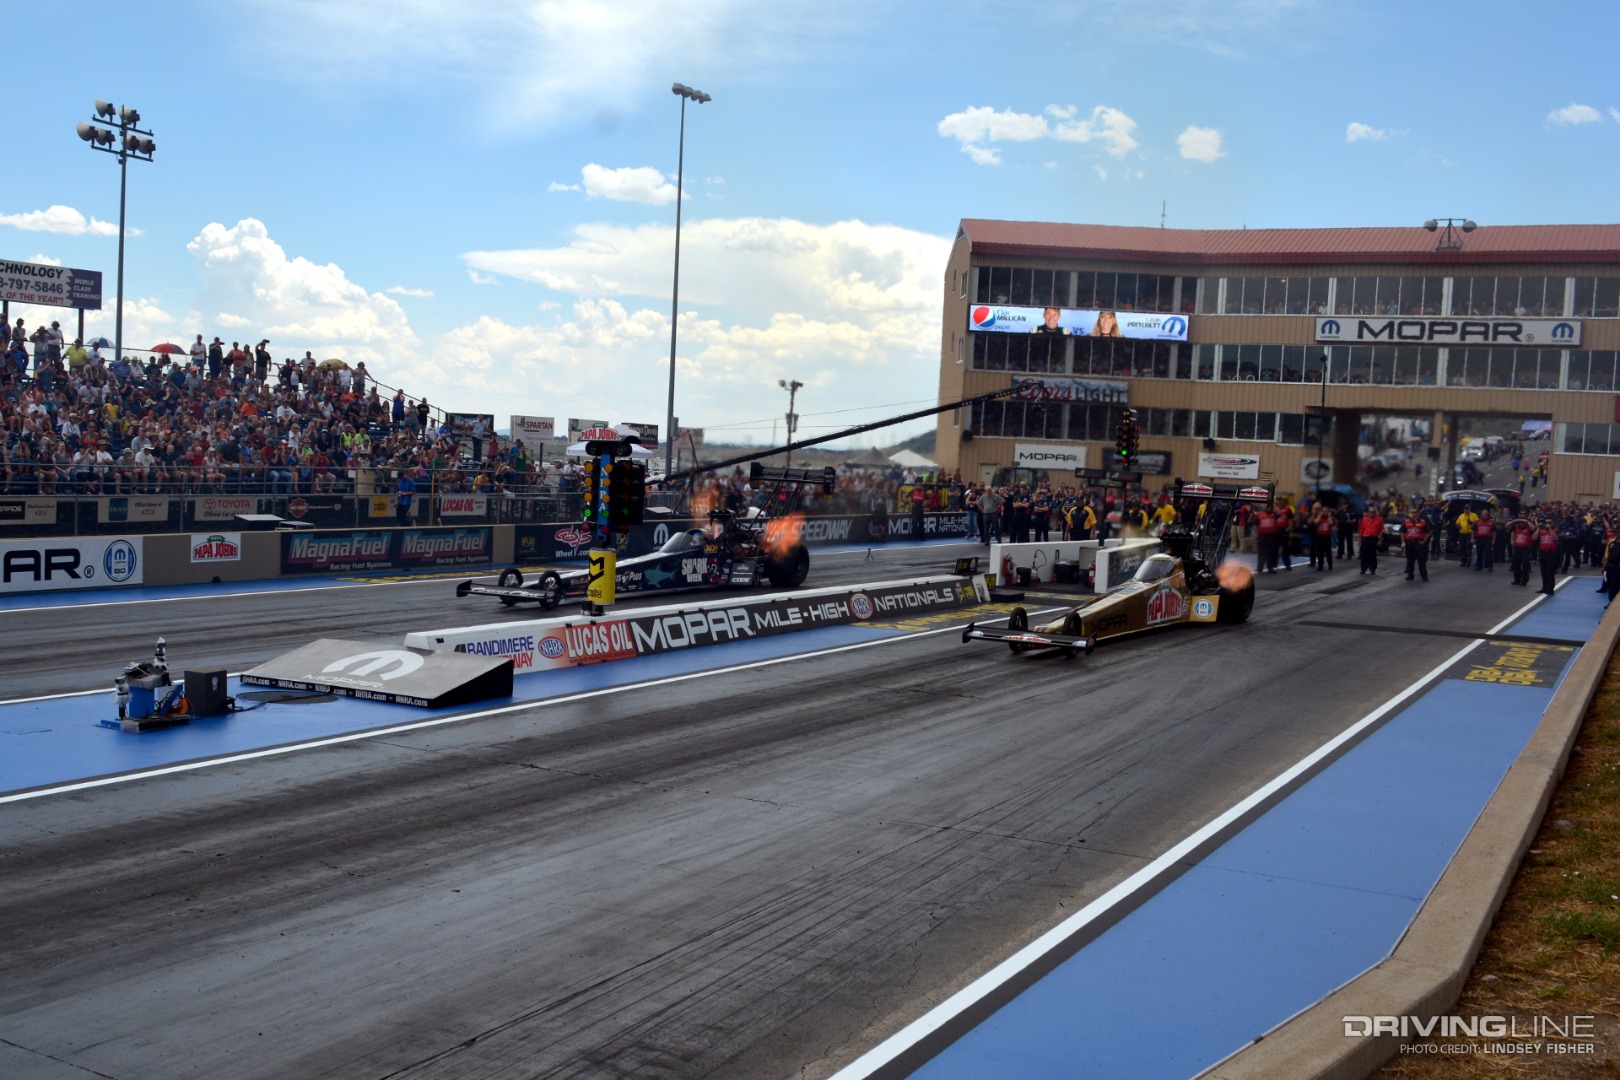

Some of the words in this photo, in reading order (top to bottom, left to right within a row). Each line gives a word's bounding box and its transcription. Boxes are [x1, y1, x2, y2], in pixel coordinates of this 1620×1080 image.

[74, 278, 95, 286] WORLD
[6, 292, 17, 301] OF
[19, 293, 36, 303] THE
[1357, 320, 1523, 342] MOPAR
[1074, 386, 1126, 402] LIGHT
[526, 421, 553, 430] SPARTAN
[582, 429, 597, 439] PAPA
[1019, 452, 1077, 462] MOPAR
[217, 499, 251, 508] TOYOTA
[442, 499, 464, 512] LUCAS
[464, 498, 474, 511] OIL
[204, 510, 221, 518] Official
[793, 519, 852, 541] SPEEDWAY
[938, 523, 968, 532] NATIONAL
[194, 543, 213, 558] PAPA
[291, 535, 388, 562] MagnaFuel
[402, 533, 485, 559] MagnaFuel
[436, 556, 454, 564] Racing
[467, 555, 489, 563] Systems
[555, 550, 573, 558] Wheel
[329, 563, 351, 571] Racing
[366, 561, 392, 570] Systems
[681, 557, 708, 576] SHARK
[686, 573, 703, 583] WEEK
[873, 587, 954, 611] NATIONALS
[1091, 613, 1128, 632] MOPAR
[631, 608, 753, 653] MOPAR
[541, 638, 564, 656] NHRA
[564, 625, 610, 658] LUCAS
[610, 622, 633, 653] OIL
[301, 673, 384, 688] MOPAR
[242, 676, 270, 686] NHRA.com
[277, 680, 307, 690] NHRA.com
[355, 689, 387, 701] NHRA.com
[395, 695, 428, 707] NHRA.com
